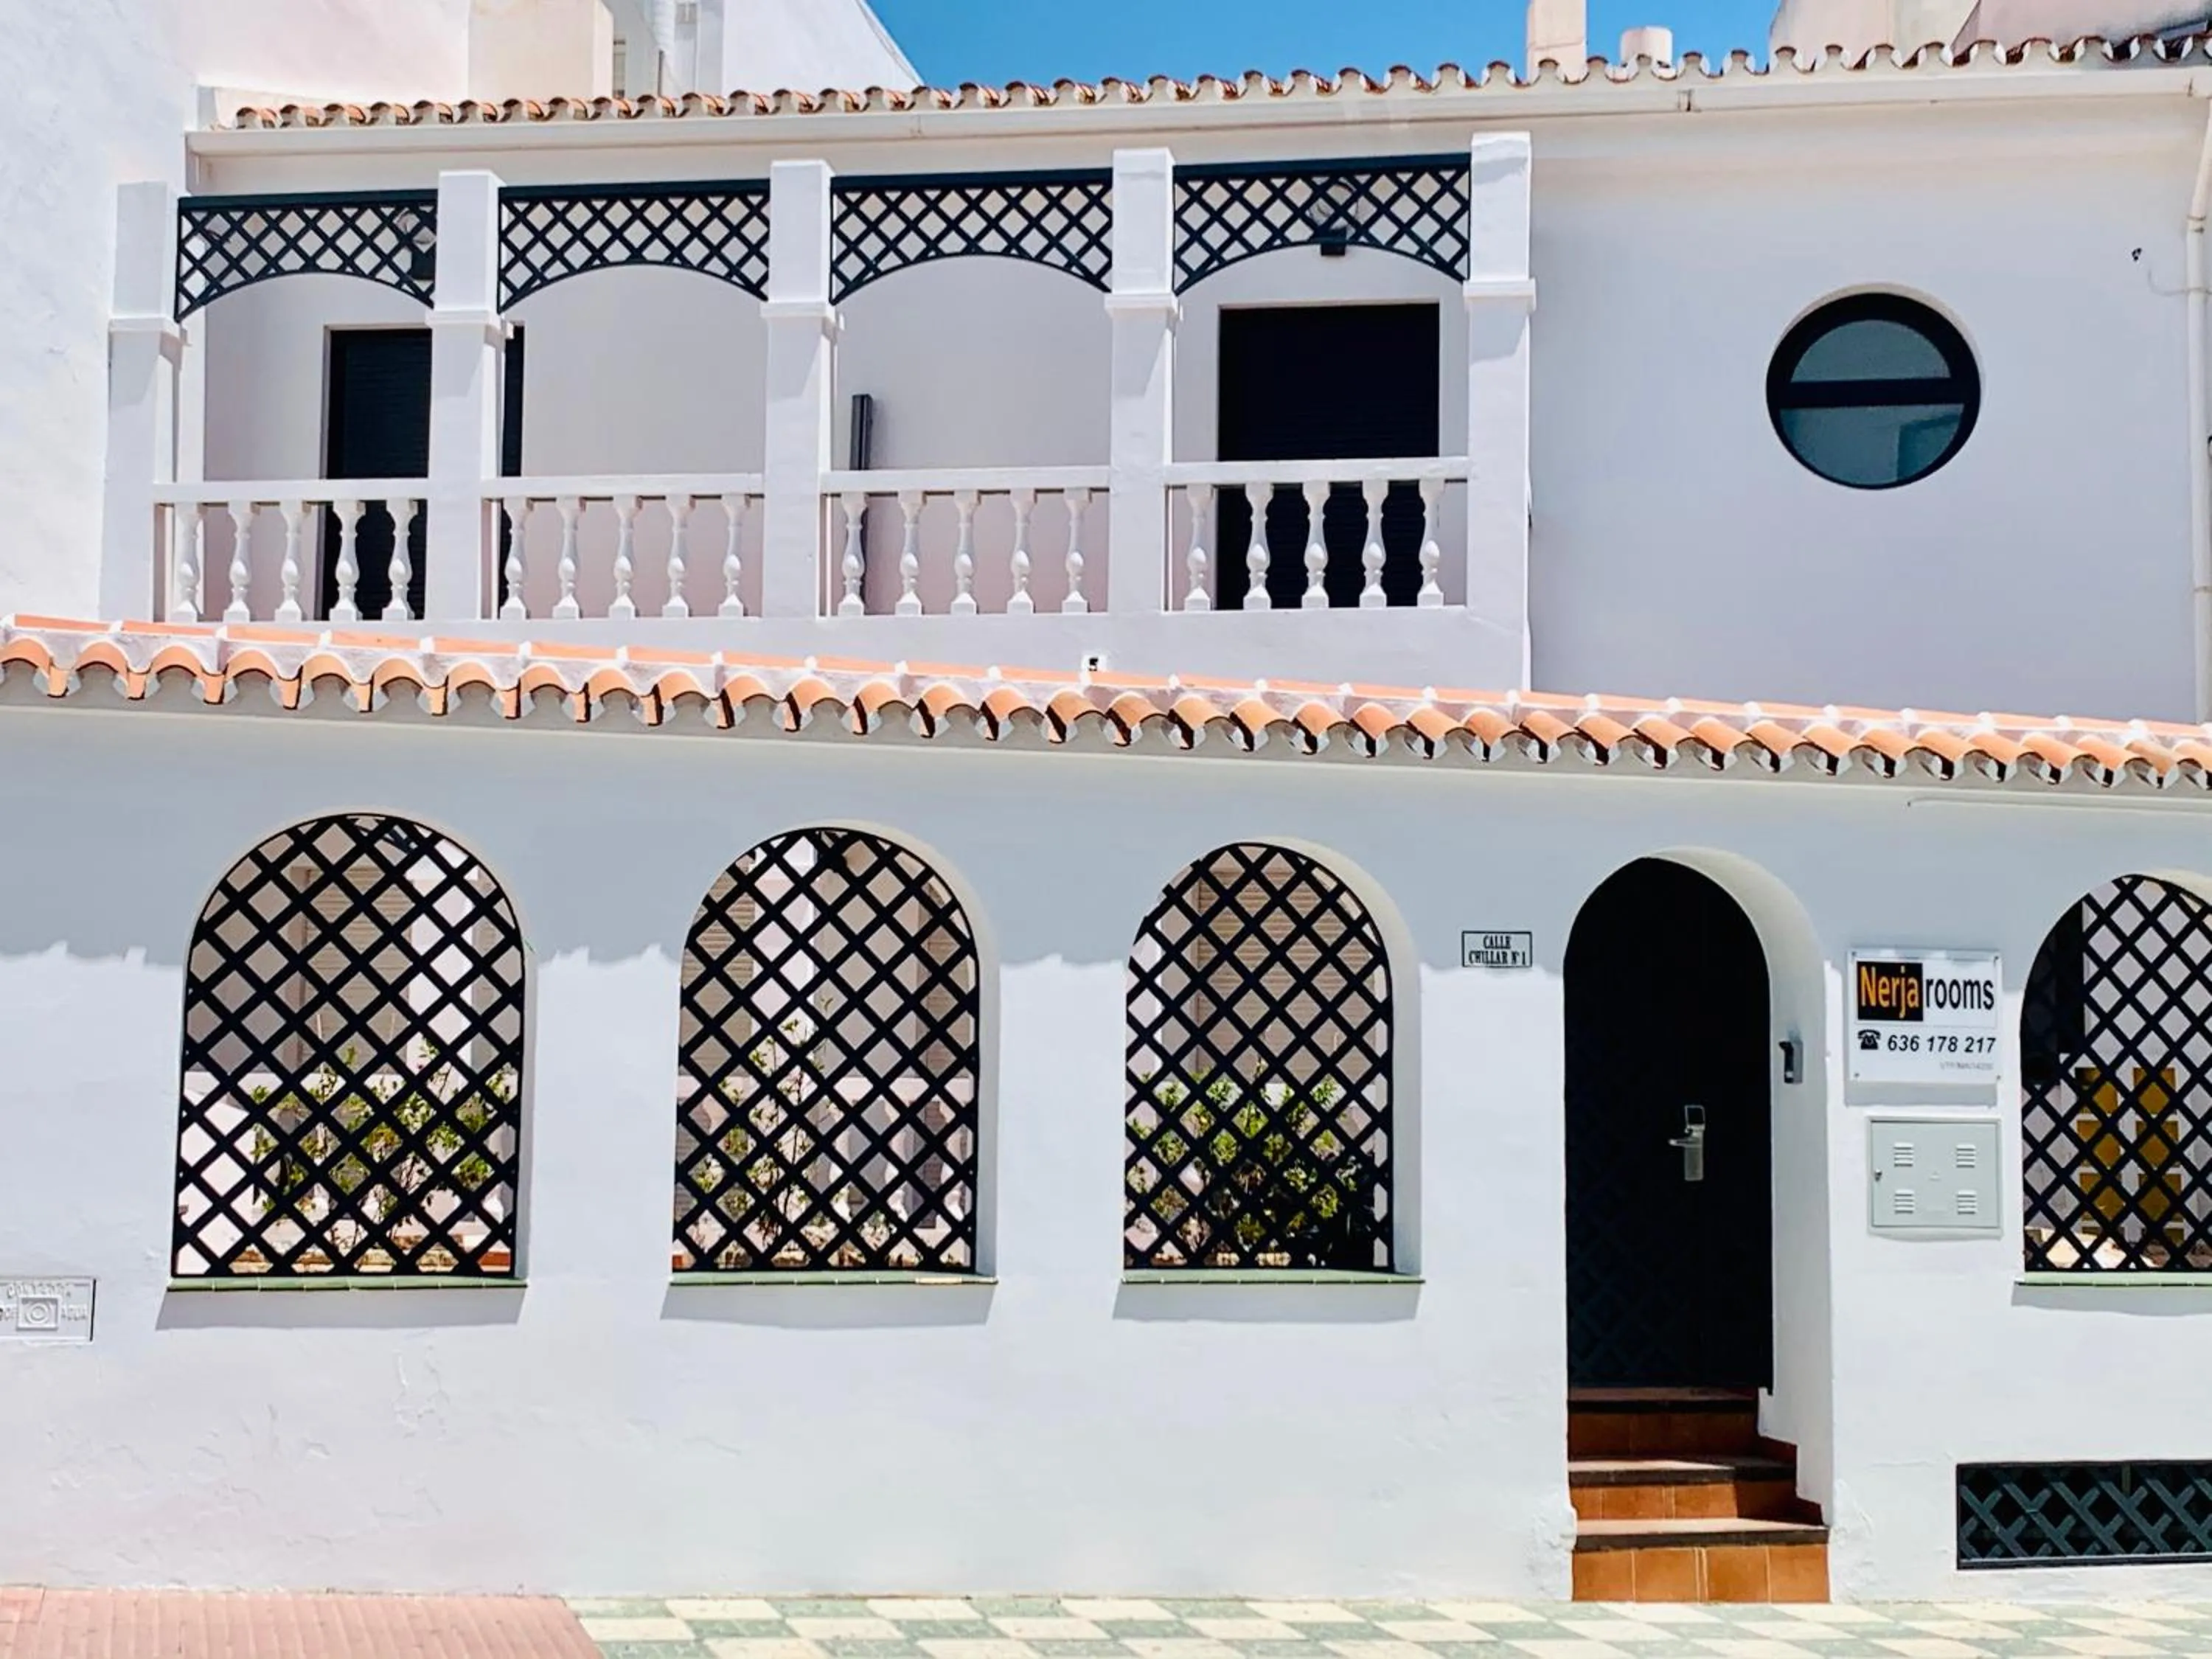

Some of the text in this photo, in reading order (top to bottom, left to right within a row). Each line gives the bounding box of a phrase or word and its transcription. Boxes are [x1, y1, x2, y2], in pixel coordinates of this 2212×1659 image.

[1484, 935, 1511, 949] CALLE
[1469, 950, 1508, 964] CHILLAR
[1860, 965, 1994, 1018] Nerja rooms
[1888, 1034, 1997, 1054] 636 178 217
